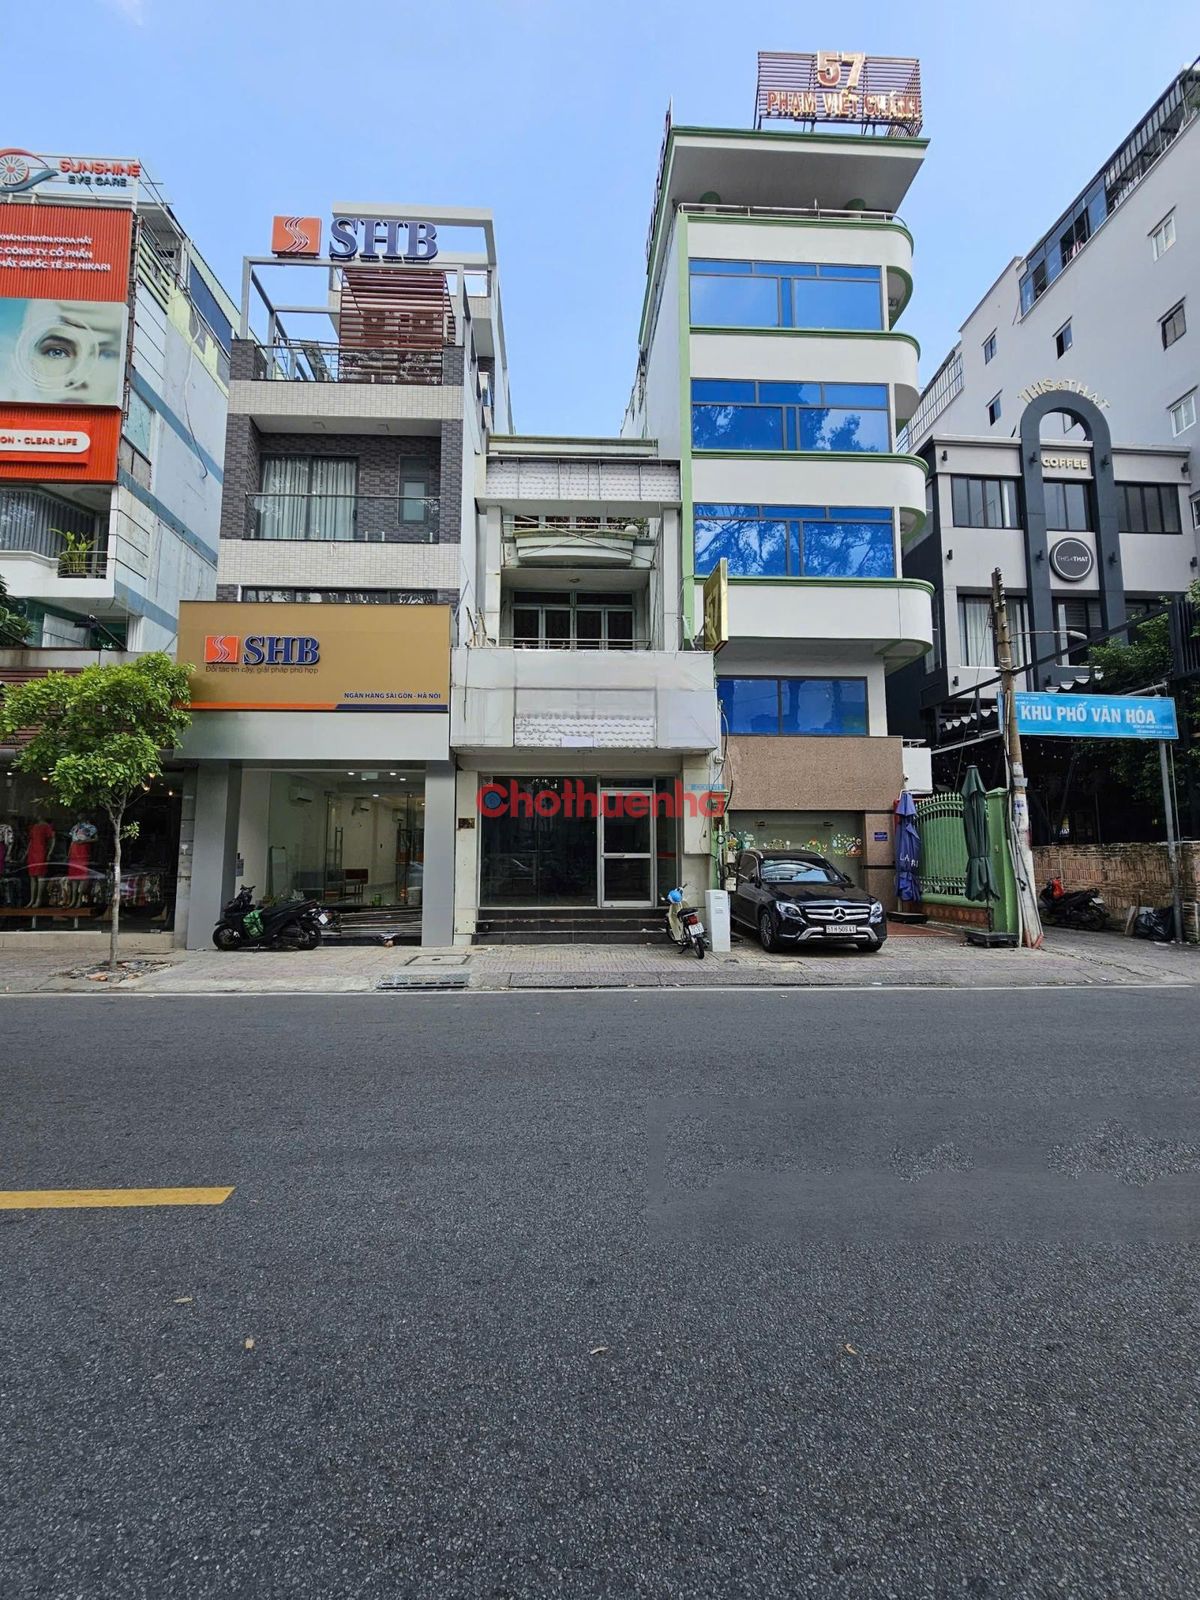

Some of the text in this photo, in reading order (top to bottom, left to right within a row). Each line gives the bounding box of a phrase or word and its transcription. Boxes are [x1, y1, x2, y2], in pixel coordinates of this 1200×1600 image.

[817, 50, 866, 88] 57
[60, 160, 141, 177] SUNSHINE
[68, 175, 127, 187] EYE CARE
[329, 217, 438, 259] SHB
[5, 246, 33, 256] CÔNG
[35, 248, 48, 256] TY
[19, 258, 49, 269] QUỐC
[24, 437, 55, 446] CLEAR
[58, 438, 77, 446] LIFE
[1042, 457, 1088, 470] COFFEE
[243, 635, 320, 665] SHB
[1021, 702, 1157, 724] KHU PHỐ VĂN HÓA
